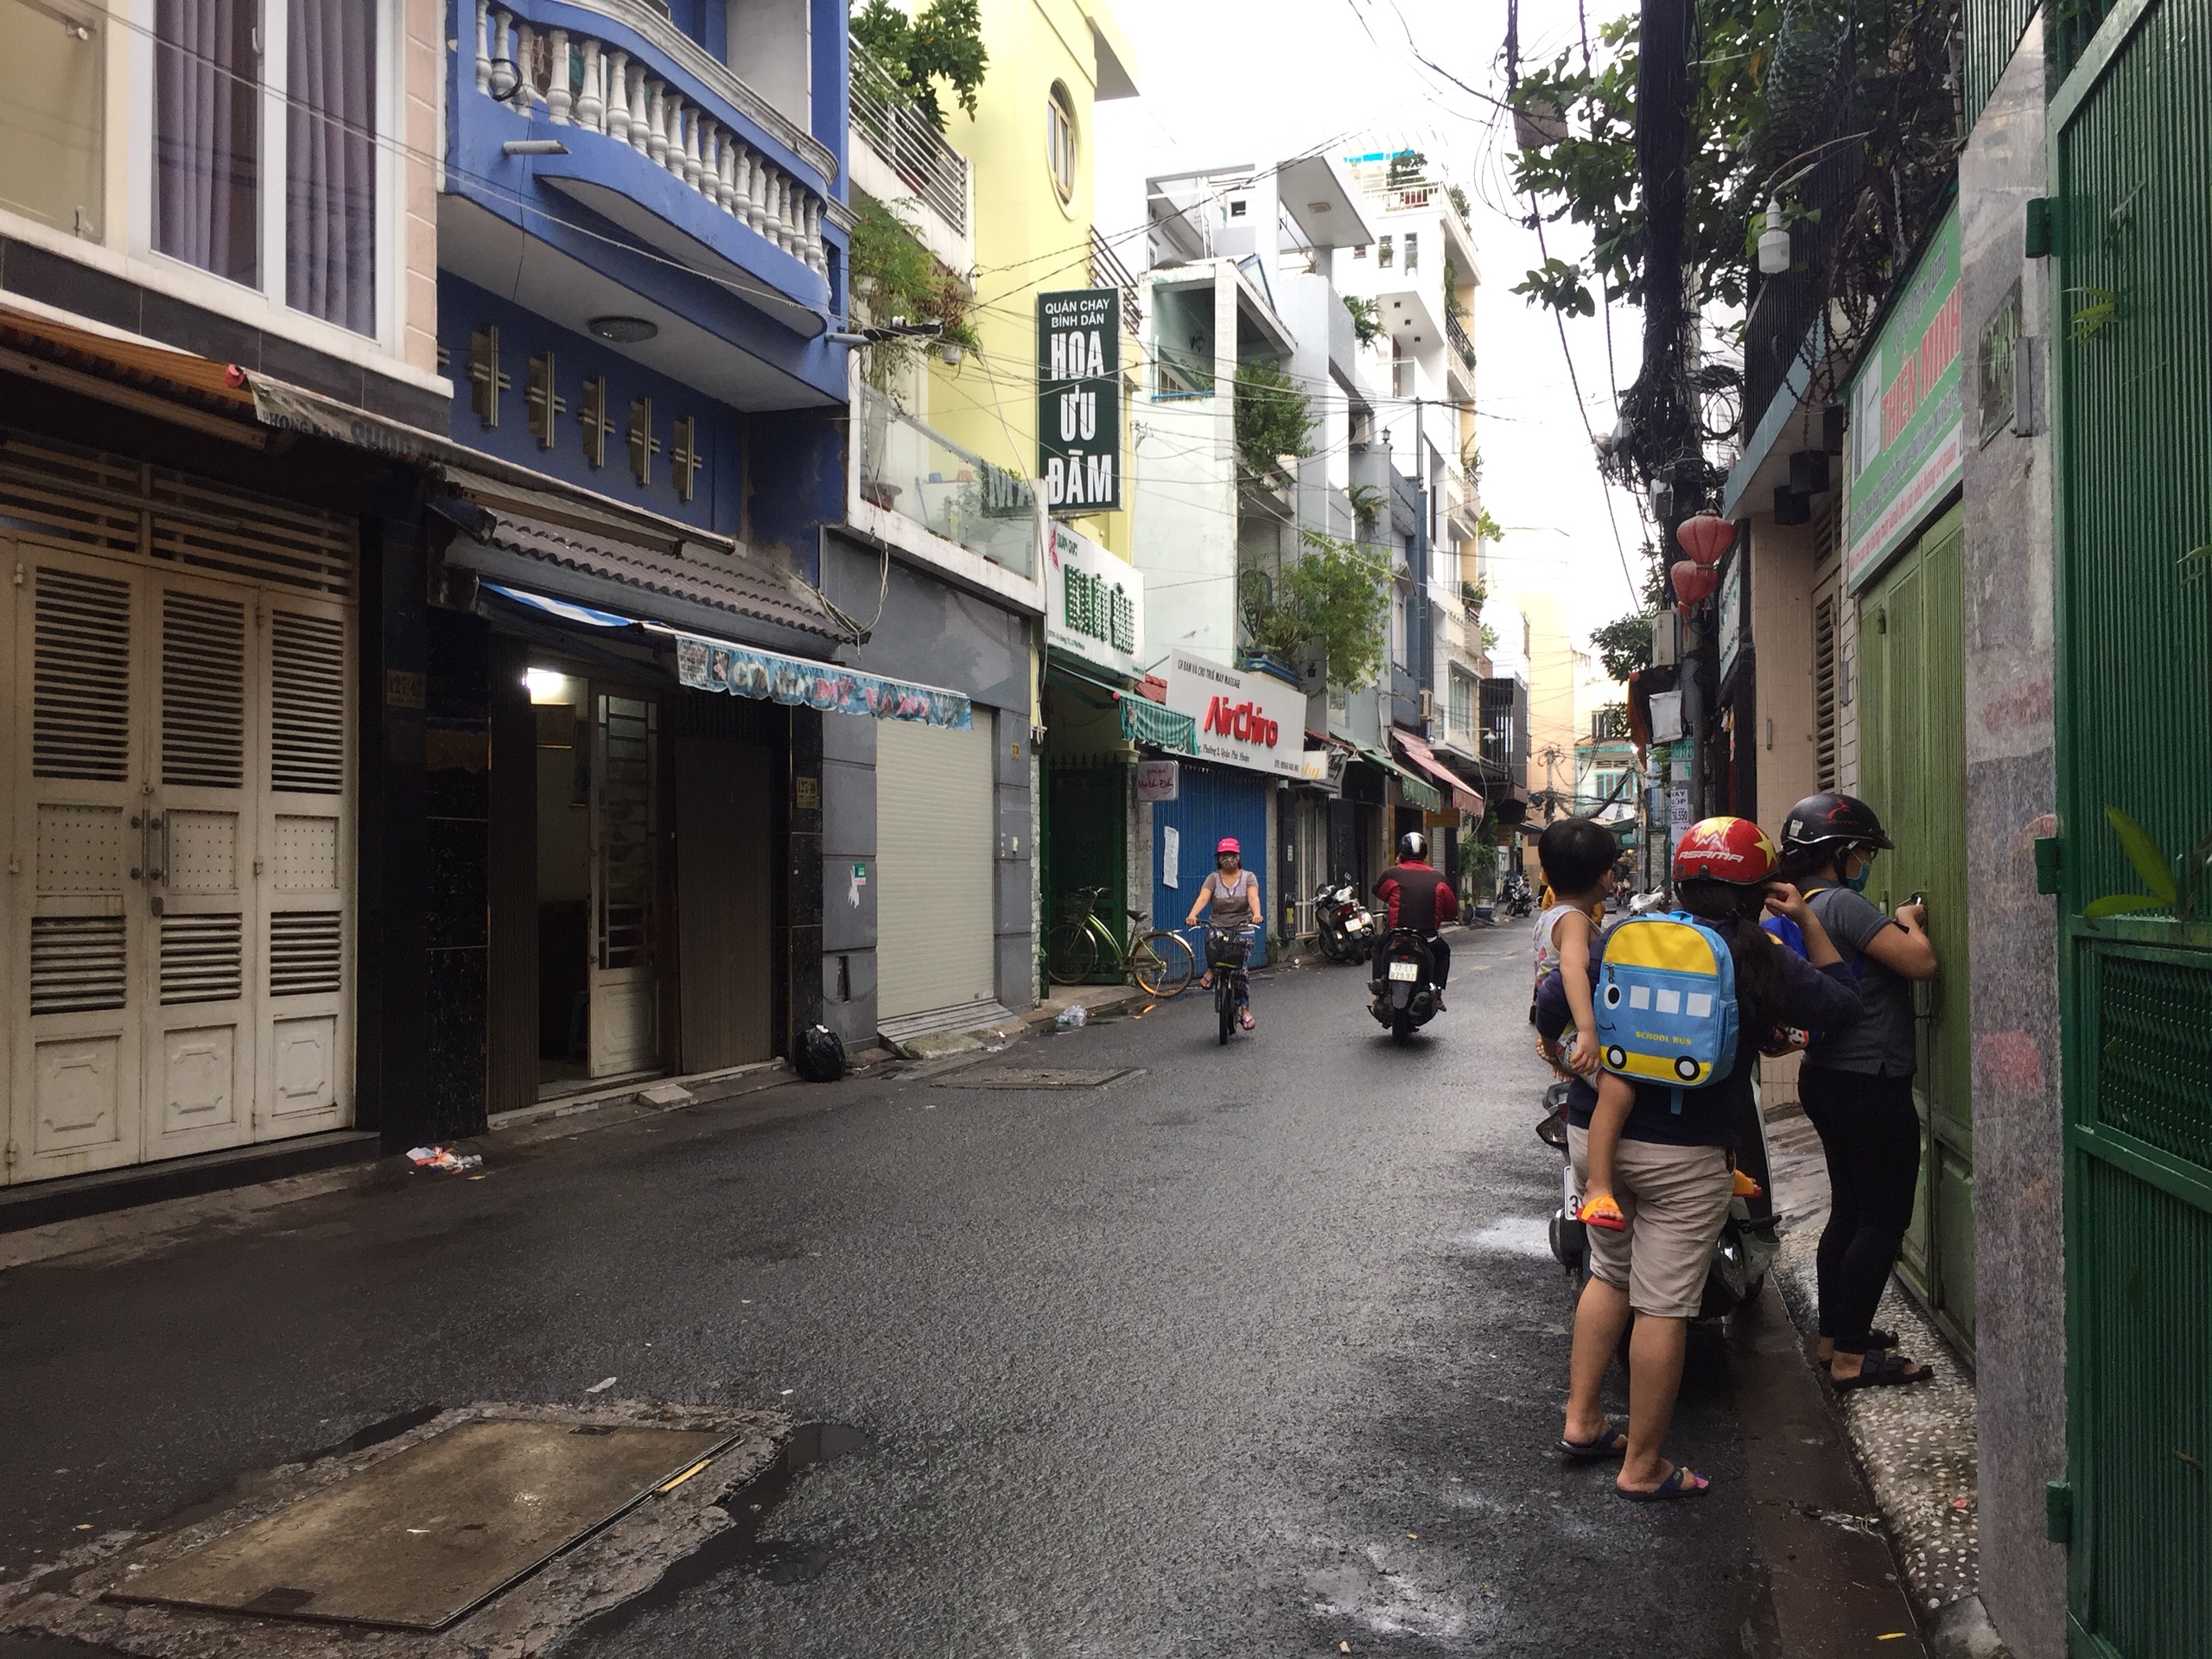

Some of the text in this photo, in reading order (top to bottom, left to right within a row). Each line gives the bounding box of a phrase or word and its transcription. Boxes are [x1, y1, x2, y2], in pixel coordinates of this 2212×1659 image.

[1045, 298, 1110, 315] QUÁN CHAY
[1081, 312, 1104, 326] DÂN
[1051, 330, 1105, 381] HOA
[1060, 385, 1096, 442] ƯU
[1204, 696, 1278, 747] AirChiro
[1678, 850, 1745, 862] ASAMA
[1635, 1031, 1692, 1046] SCHOOL BUS
